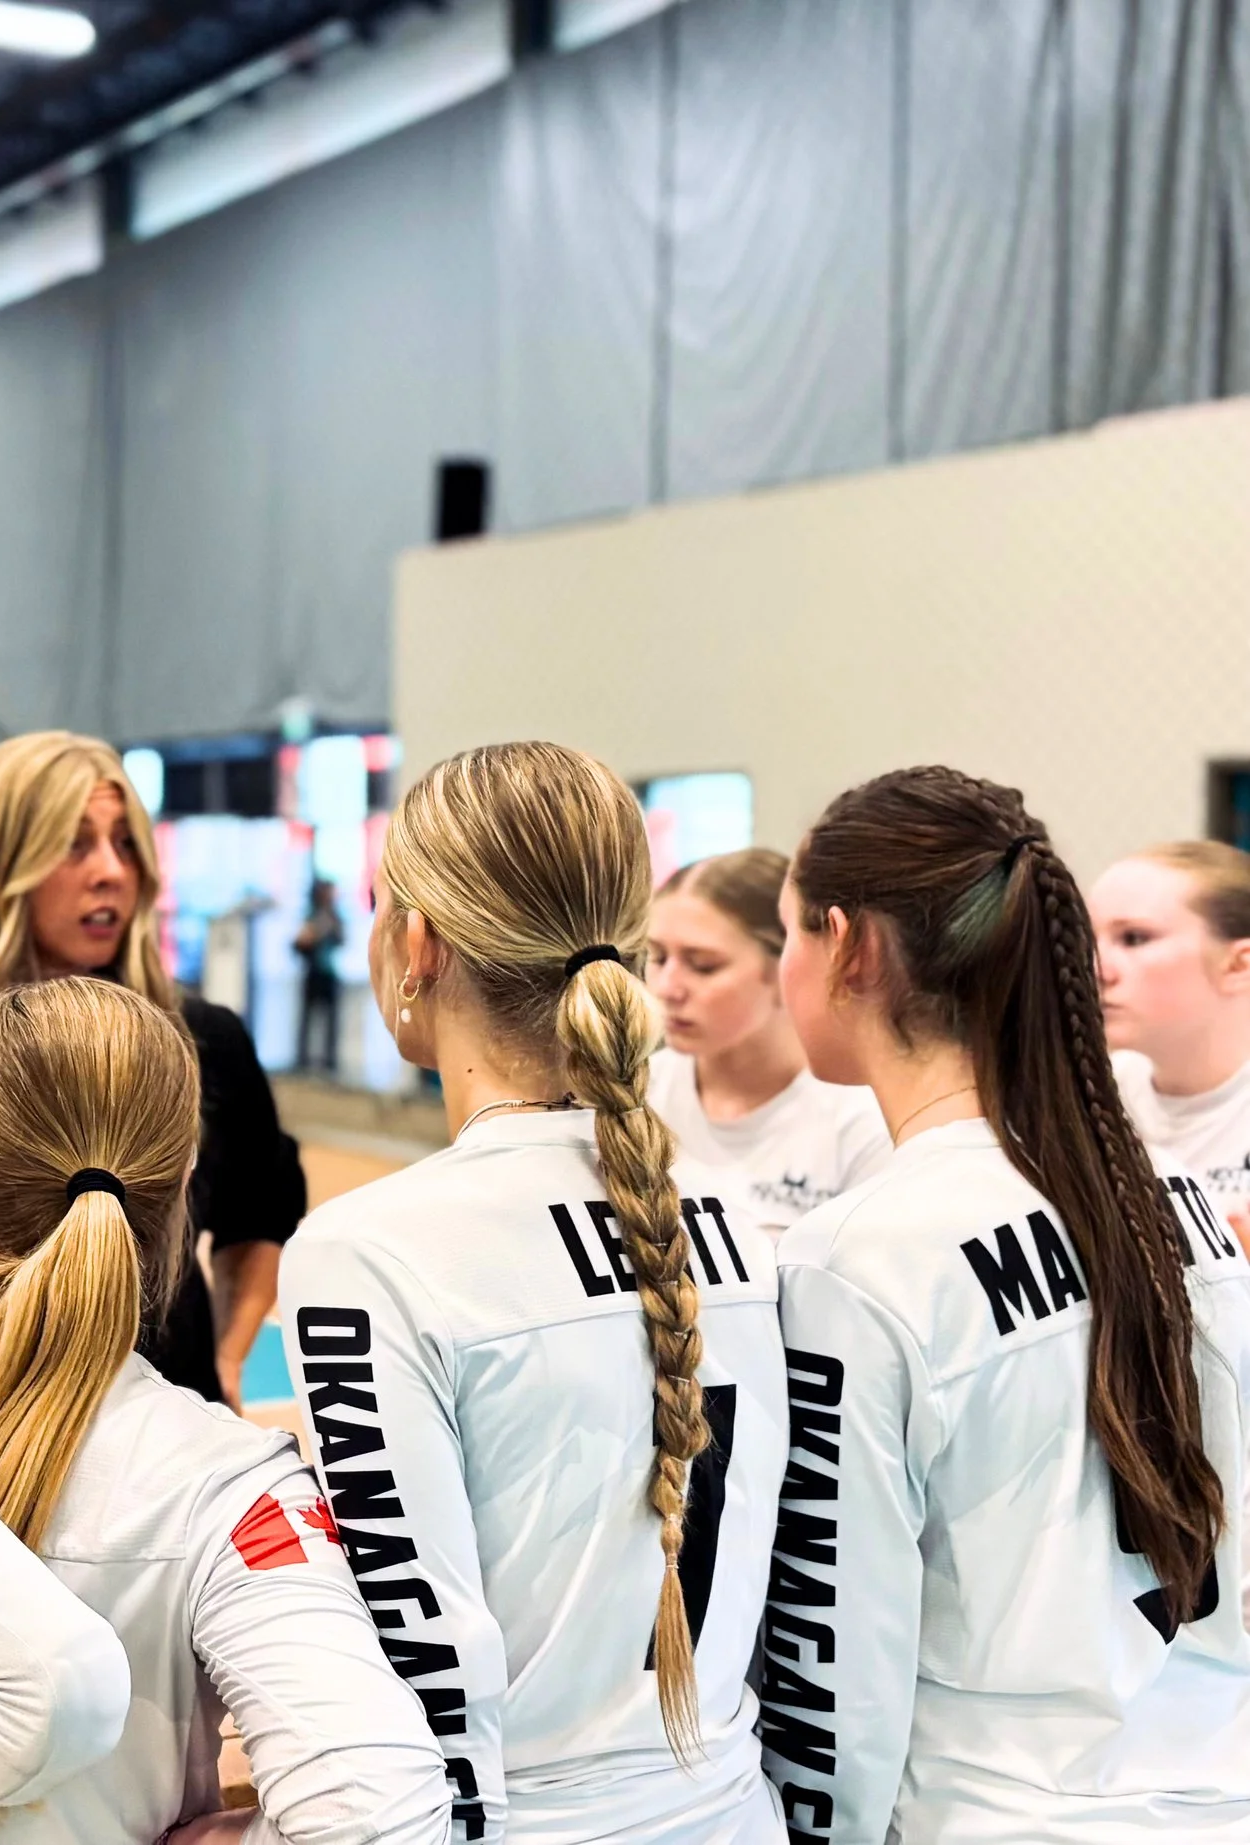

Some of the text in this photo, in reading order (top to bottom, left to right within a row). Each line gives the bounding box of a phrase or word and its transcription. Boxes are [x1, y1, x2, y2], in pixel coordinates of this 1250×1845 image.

[297, 1306, 467, 1737] OKANAGAN
[643, 1383, 737, 1671] 7
[760, 1347, 845, 1776] OKANAGAN
